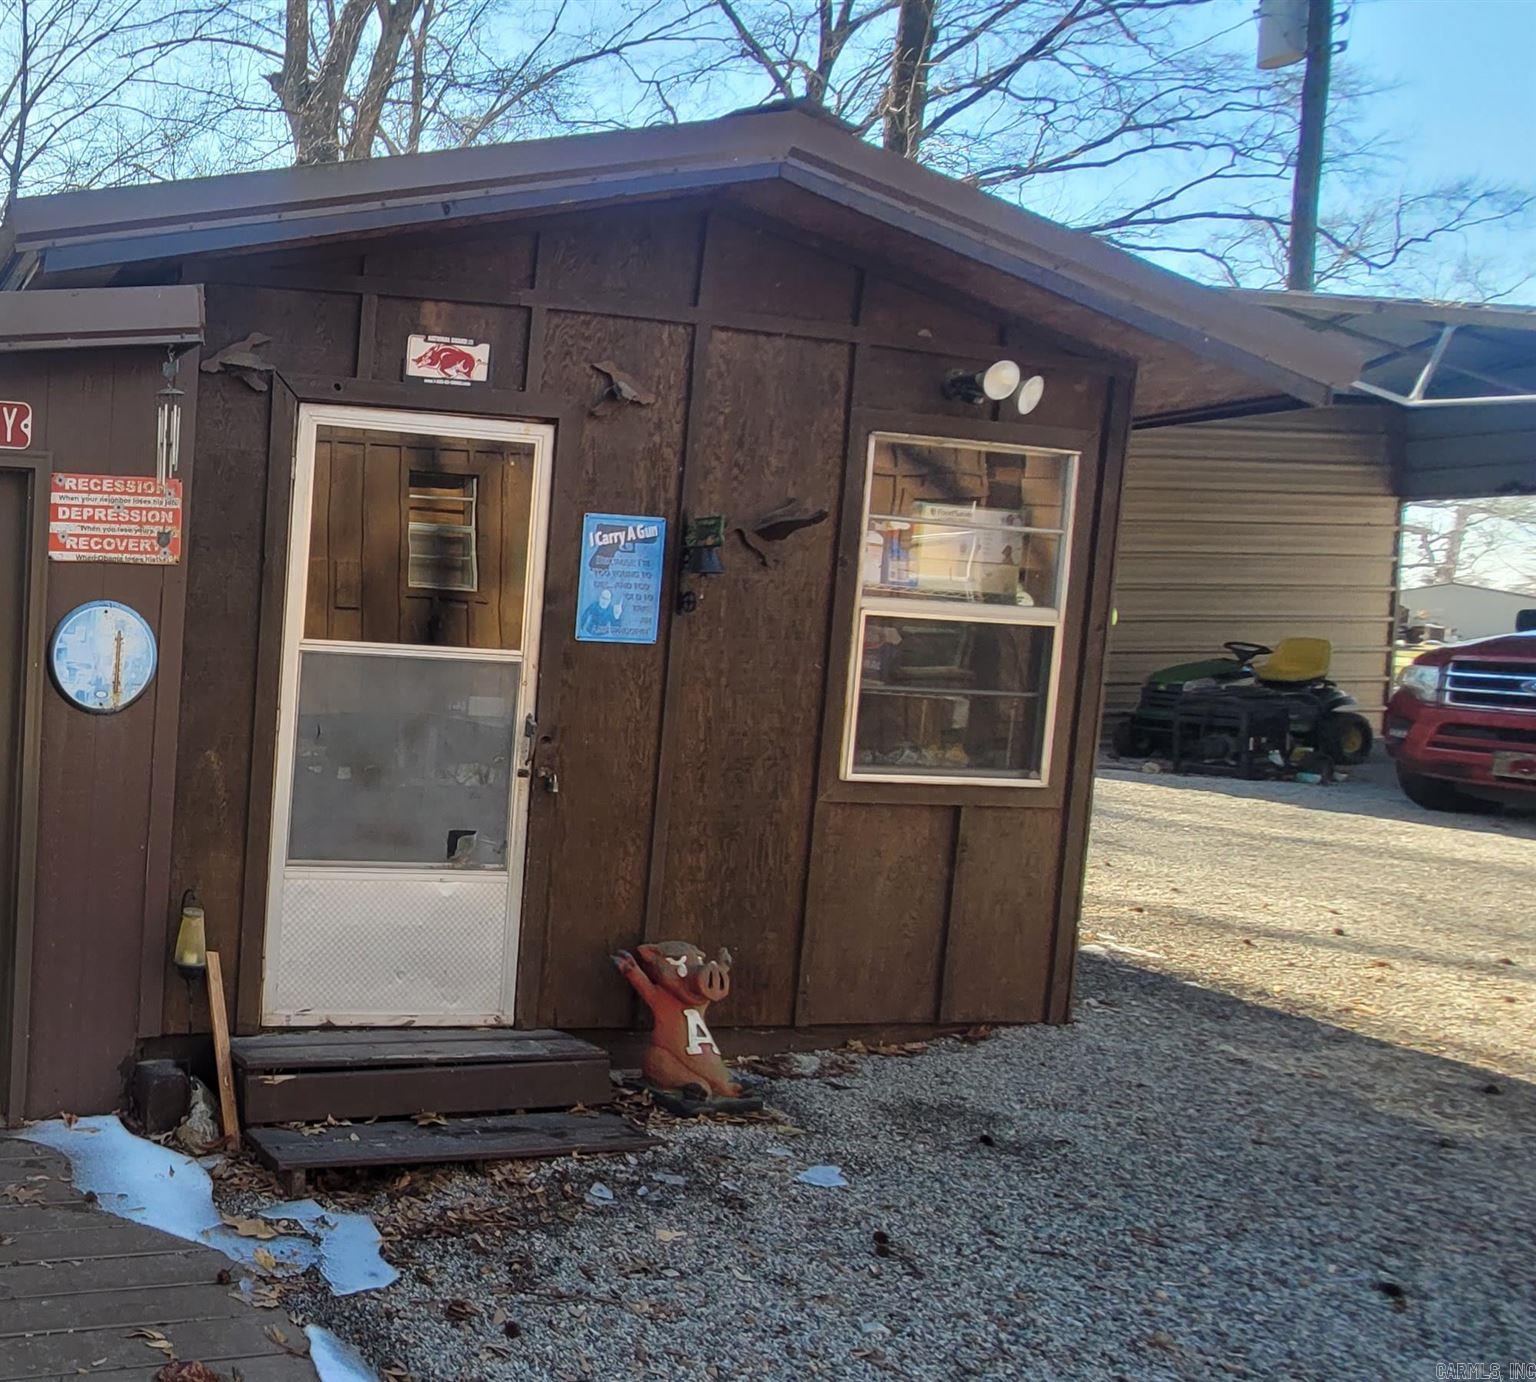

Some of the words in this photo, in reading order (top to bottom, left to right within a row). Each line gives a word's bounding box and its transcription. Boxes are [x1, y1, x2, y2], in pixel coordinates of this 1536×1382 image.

[57, 507, 173, 523] DEPRESSION
[589, 532, 594, 548] I
[595, 531, 625, 546] Carry
[627, 526, 636, 541] A
[636, 524, 658, 539] Gun
[683, 1008, 722, 1056] A
